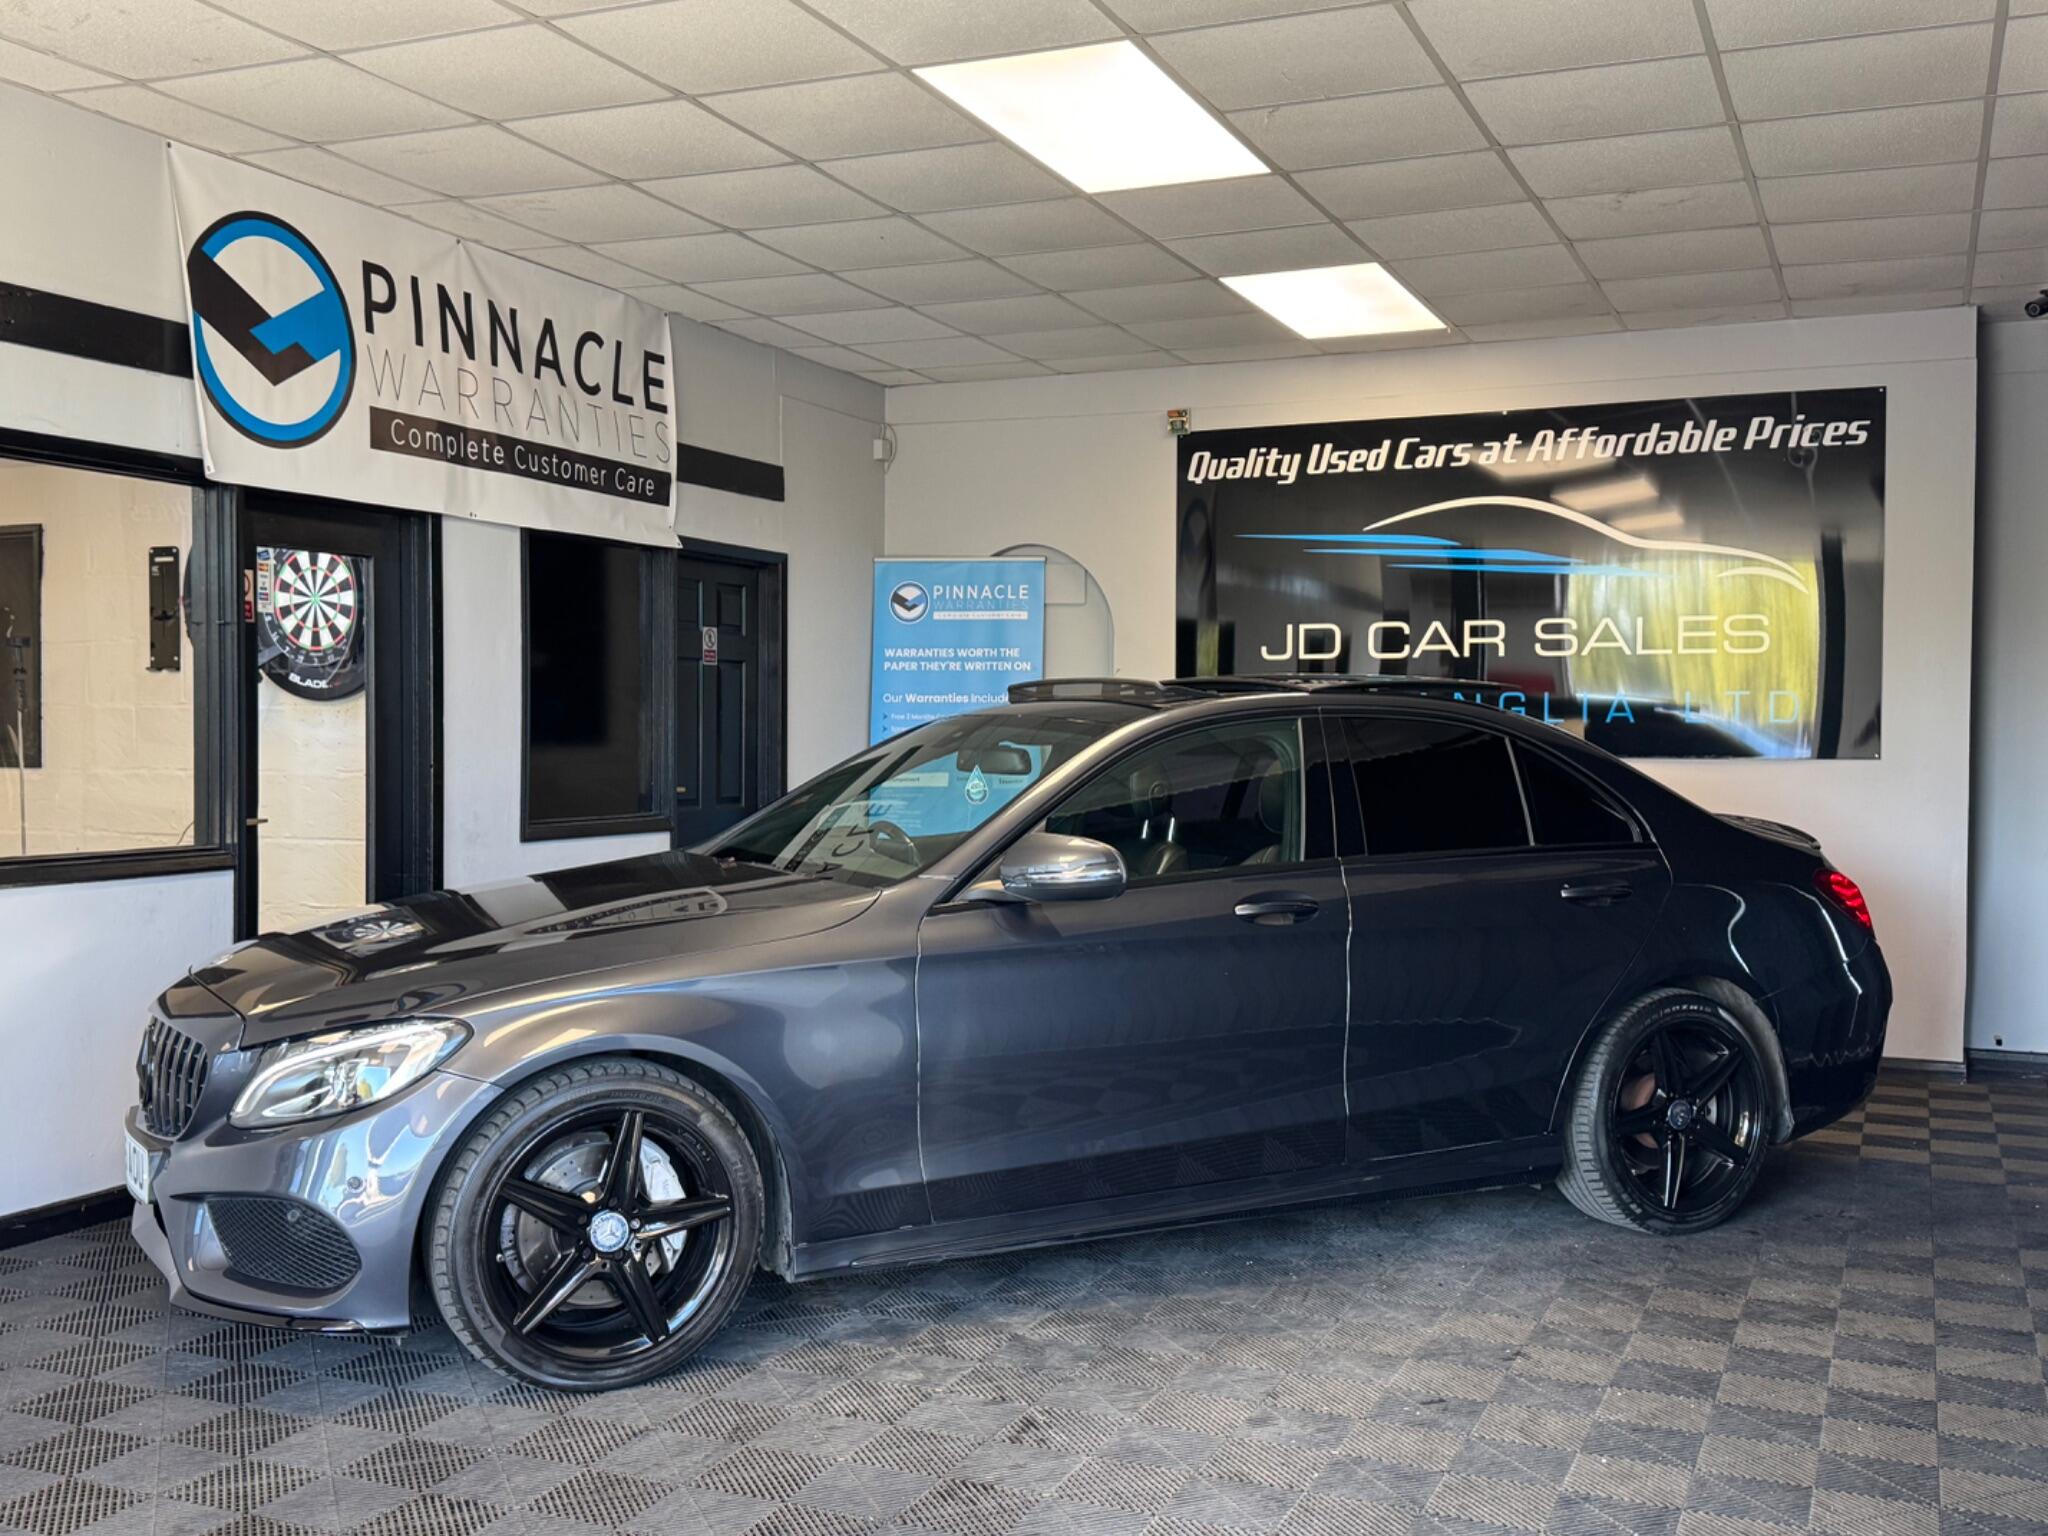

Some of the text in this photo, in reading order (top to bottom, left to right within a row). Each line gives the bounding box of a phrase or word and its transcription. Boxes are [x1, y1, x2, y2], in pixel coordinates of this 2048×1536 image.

[362, 260, 669, 415] PINNACLE
[366, 344, 671, 464] WARRANTIES
[390, 418, 655, 497] Complete Customer Care
[1187, 415, 1871, 485] Quality Used Cars at Affordable Prices
[933, 584, 1029, 600] PINNACLE
[884, 648, 1020, 658] WARRANTIES WORTH THE
[1260, 613, 1771, 661] JD CAR SALES
[884, 661, 1032, 671] PAPER THEY'RE WRITTEN ON
[882, 693, 1008, 703] Our Warranties Includ
[1685, 690, 1799, 724] LTD
